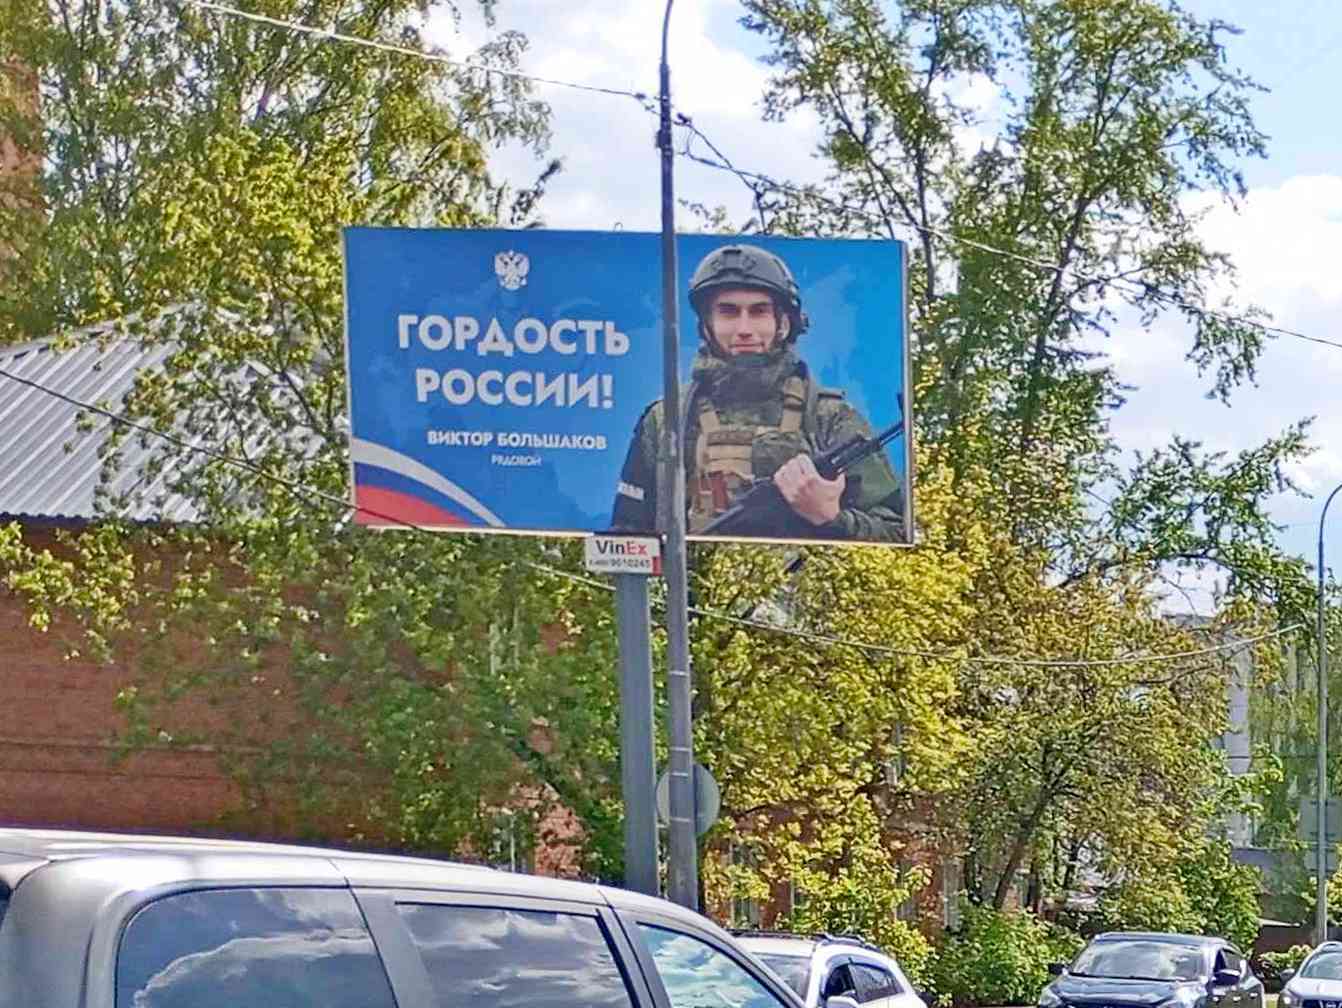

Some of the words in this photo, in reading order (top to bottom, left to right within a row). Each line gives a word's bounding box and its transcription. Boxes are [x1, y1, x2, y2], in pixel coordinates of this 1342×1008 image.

[397, 313, 631, 358] ГОРДОСТЬ
[415, 367, 616, 410] РОССИИ!
[427, 430, 493, 447] ВИКТОР
[497, 432, 607, 450] БОЛЬШАКОВ
[595, 540, 649, 556] VinEx
